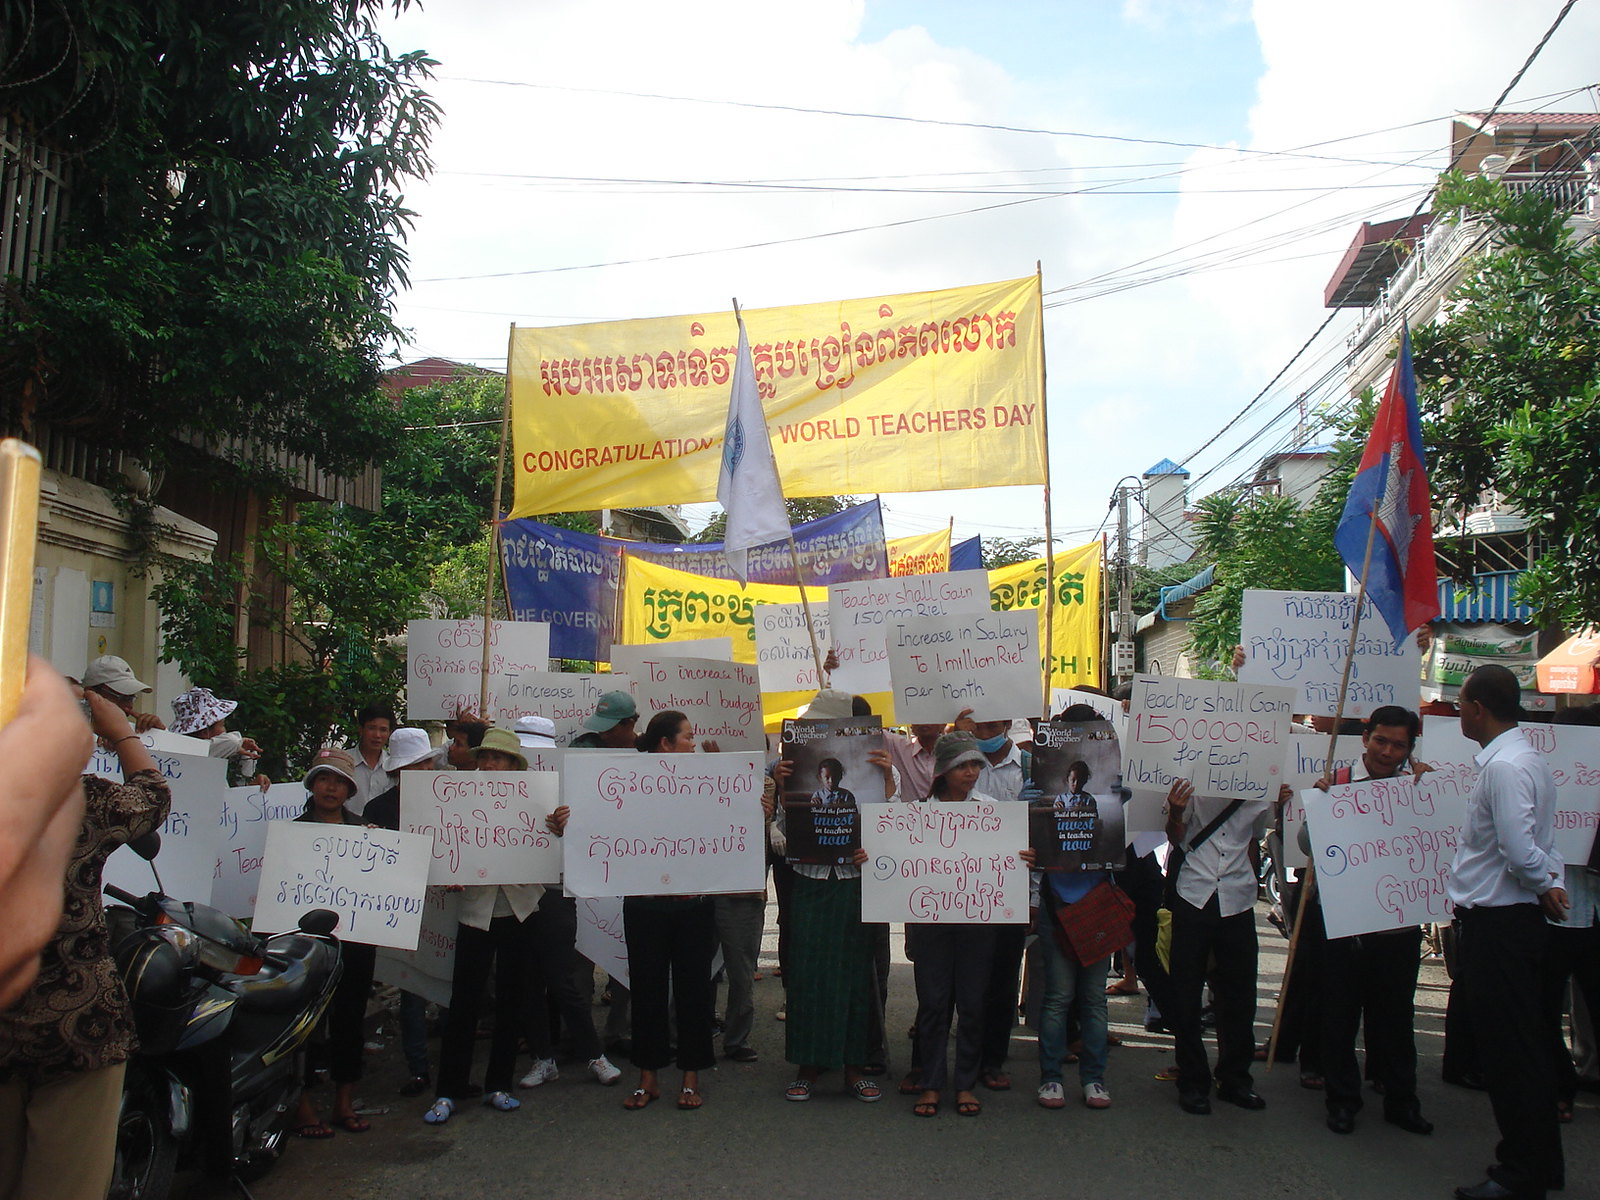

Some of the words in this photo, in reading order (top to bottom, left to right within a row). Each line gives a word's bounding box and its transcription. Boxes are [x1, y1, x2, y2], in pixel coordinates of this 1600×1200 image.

[523, 437, 722, 473] CONGRATULATION
[778, 416, 861, 444] WORLD
[867, 407, 987, 436] TEACHERS
[993, 403, 1036, 428] DAY
[834, 583, 890, 609] Teacher
[895, 580, 933, 606] shall
[940, 583, 973, 602] Gain
[512, 608, 536, 623] HE
[541, 608, 615, 629] GOVERN
[917, 601, 947, 617] Riel
[897, 624, 954, 648] Increase
[958, 625, 972, 641] in
[976, 618, 1029, 649] Salary
[859, 638, 889, 664] Eac
[910, 655, 928, 673] To
[945, 649, 996, 672] million
[996, 643, 1025, 664] Riel
[642, 661, 667, 682] To
[505, 673, 519, 697] To
[523, 683, 575, 698] increase
[580, 677, 603, 698] The
[904, 685, 934, 705] per
[942, 680, 985, 699] Month
[1139, 680, 1199, 711] Teacher
[1202, 686, 1244, 713] shall
[1250, 691, 1291, 713] Gain
[553, 703, 598, 724] budget
[649, 690, 711, 711] National
[719, 689, 762, 726] budget
[691, 721, 748, 739] ducation
[793, 725, 816, 733] World
[1049, 728, 1072, 737] World
[1244, 720, 1279, 745] Riel
[1172, 741, 1203, 766] for
[1207, 745, 1249, 766] Each
[1207, 768, 1270, 799] Holiday
[246, 791, 309, 822] Stomac
[814, 814, 855, 826] invest
[1057, 818, 1095, 831] invest
[818, 835, 851, 846] now
[1062, 840, 1092, 851] now
